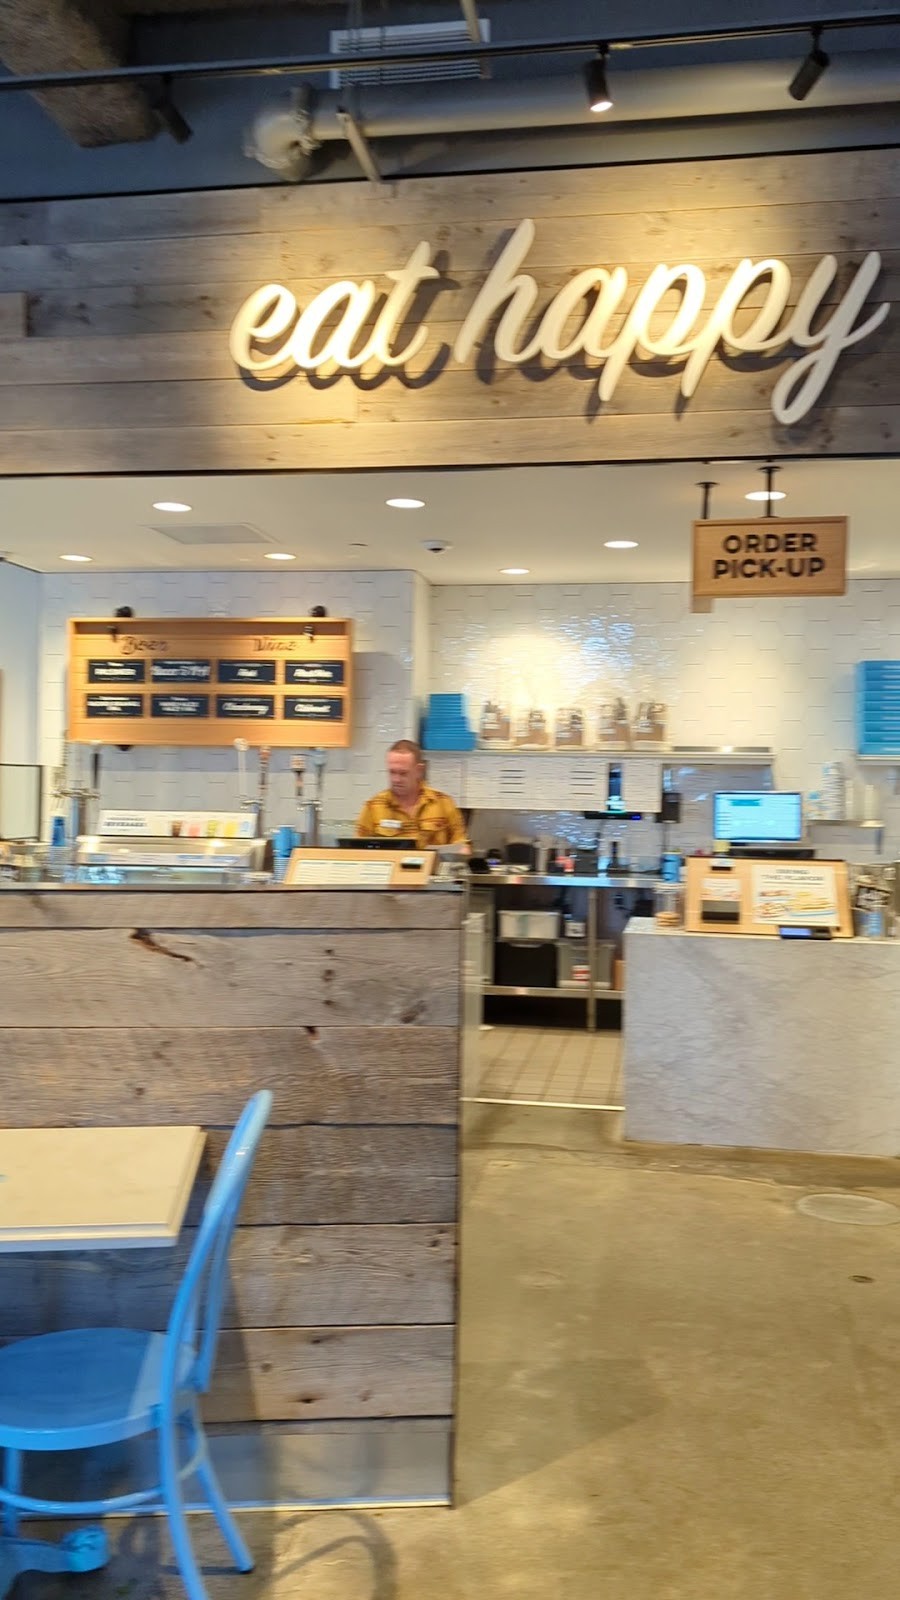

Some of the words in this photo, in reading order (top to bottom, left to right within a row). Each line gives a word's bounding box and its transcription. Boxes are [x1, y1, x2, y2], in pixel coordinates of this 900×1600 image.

[229, 241, 440, 372] eat
[455, 218, 890, 425] happy
[722, 533, 817, 554] ORDER
[712, 557, 825, 579] PICK-UP
